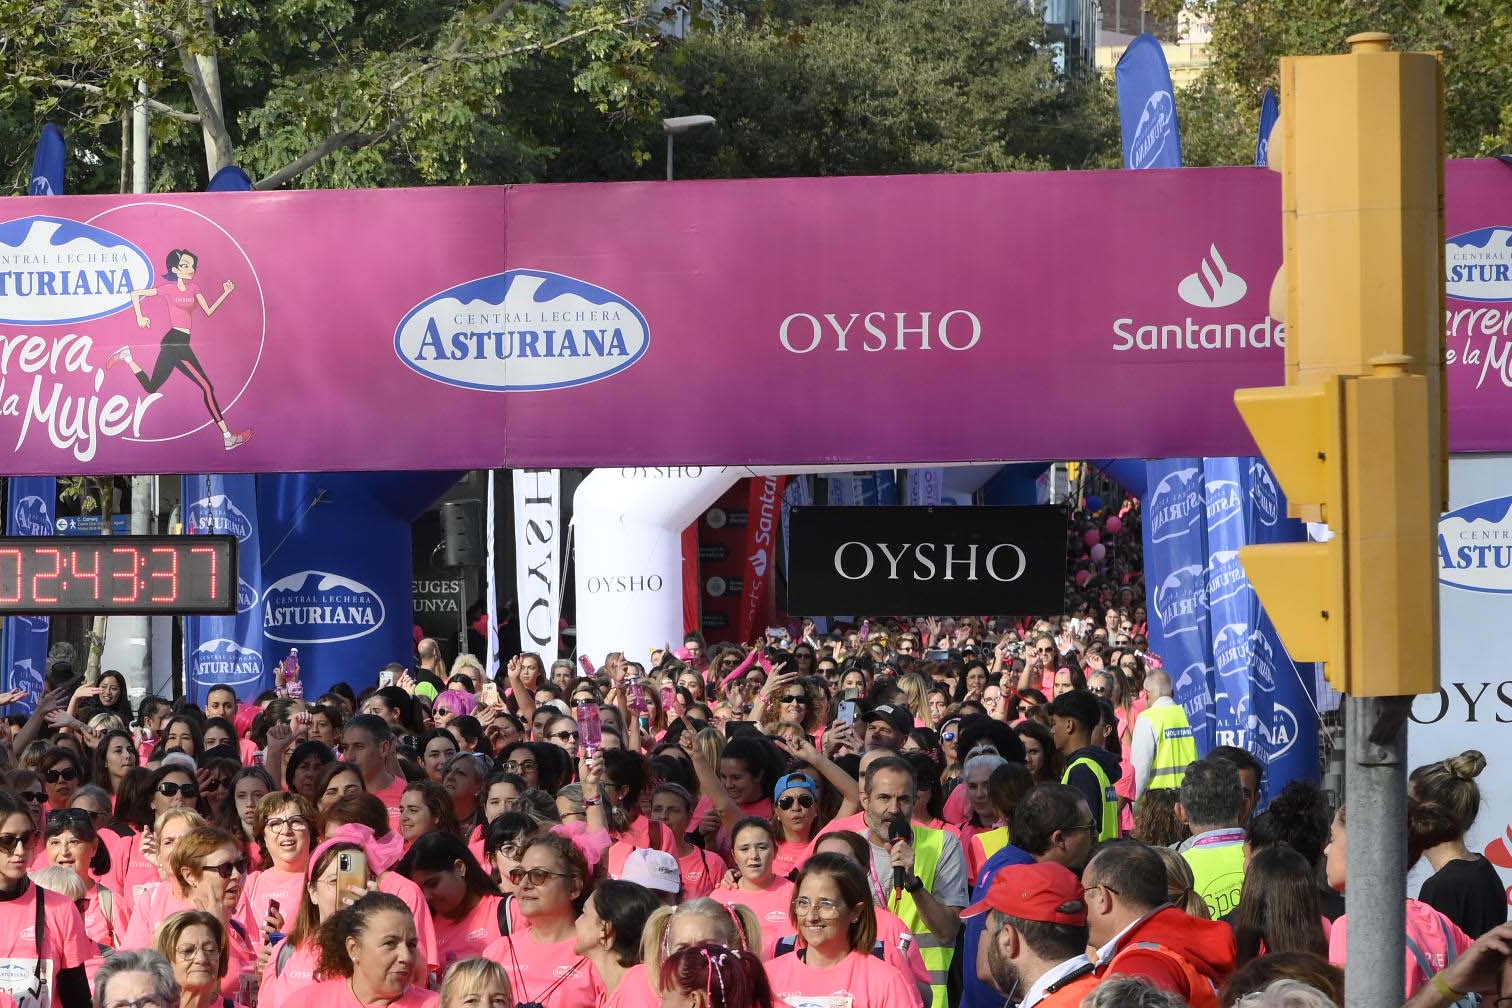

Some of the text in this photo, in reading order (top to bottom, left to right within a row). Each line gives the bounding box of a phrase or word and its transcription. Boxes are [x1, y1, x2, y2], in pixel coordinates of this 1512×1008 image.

[57, 251, 129, 264] LECHERA
[1446, 263, 1512, 284] STUR
[454, 310, 622, 324] CENTRAL LECHERA
[414, 316, 629, 361] ASTURIANA
[778, 309, 982, 354] OYSHO
[1112, 315, 1286, 351] Santande
[1463, 339, 1480, 365] la
[14, 368, 164, 462] Mujer
[833, 541, 1027, 582] OYSHO
[412, 580, 459, 593] EUGES
[587, 573, 664, 594] OYSHO
[264, 600, 376, 628] ASTURIANA
[414, 599, 458, 612] UNYA
[1204, 887, 1241, 918] Spo
